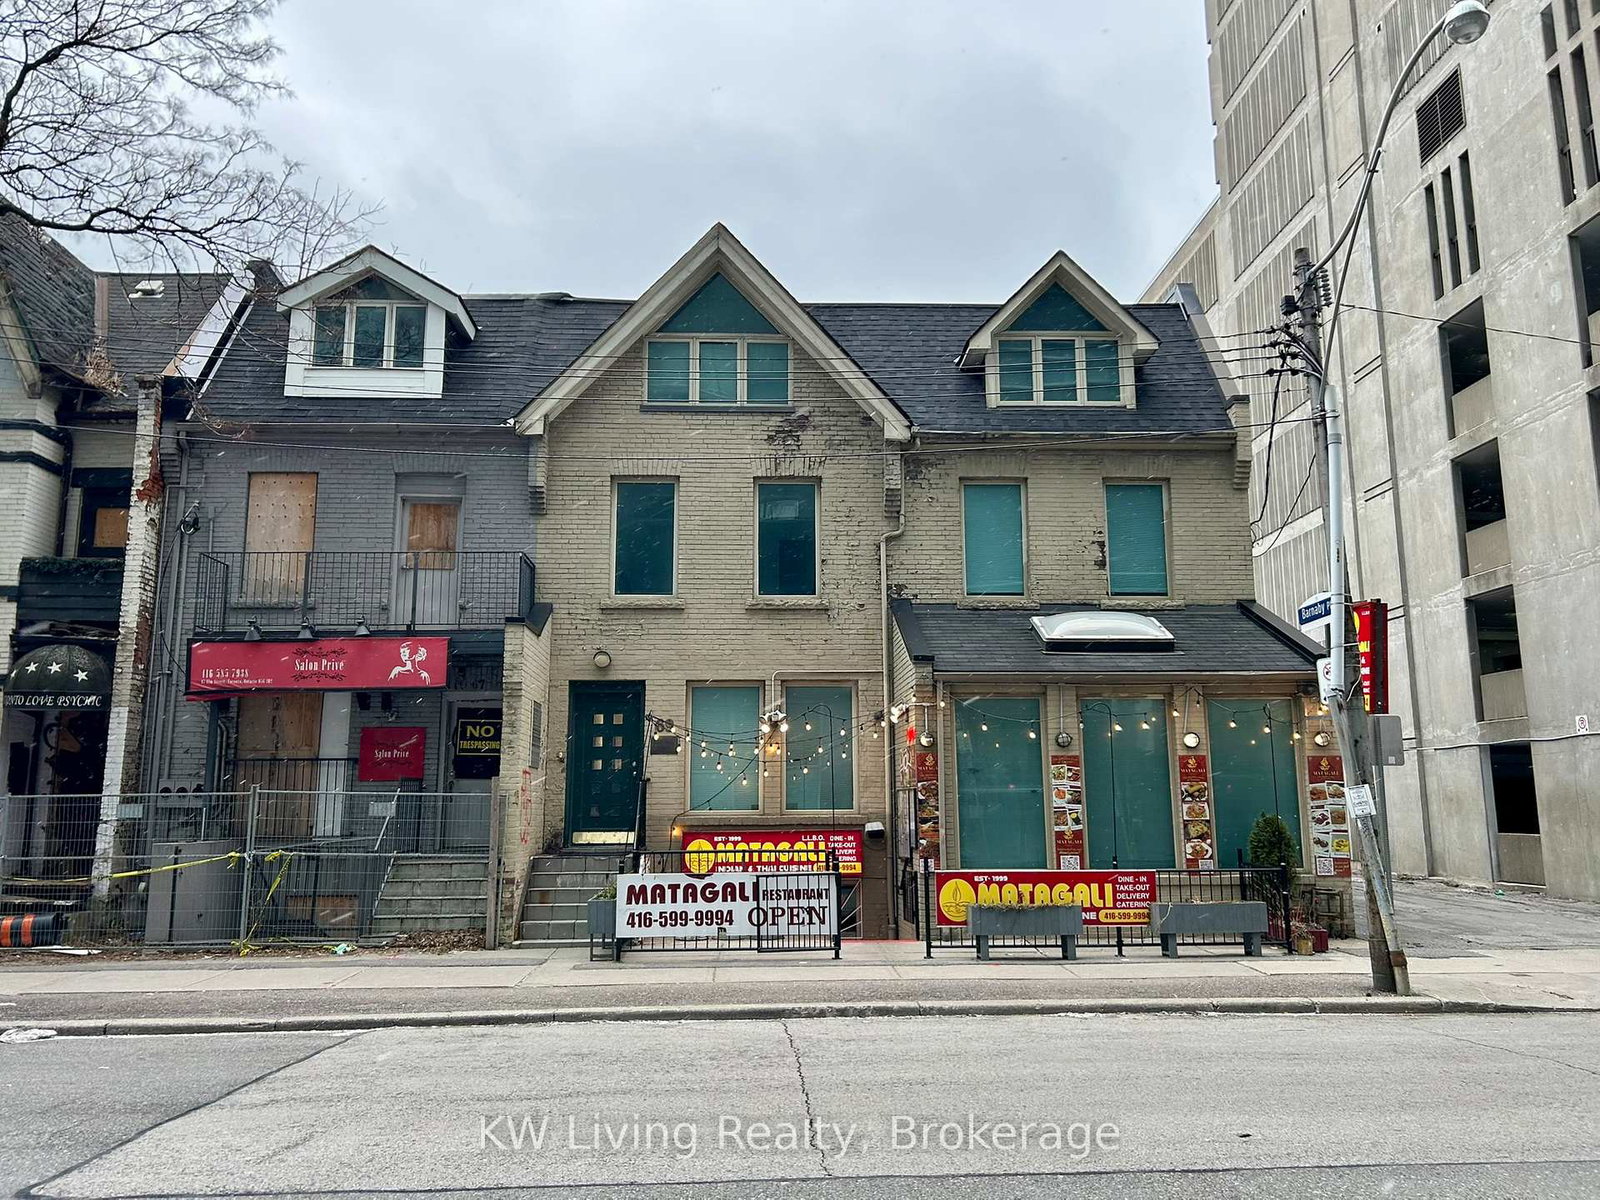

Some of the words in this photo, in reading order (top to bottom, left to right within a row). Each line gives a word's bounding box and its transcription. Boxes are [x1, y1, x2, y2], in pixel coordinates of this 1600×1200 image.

[1301, 602, 1325, 620] Barnaby
[294, 658, 319, 671] Salon
[26, 694, 54, 706] LOVE
[57, 694, 102, 707] PSYCHIC
[466, 725, 495, 738] NO
[460, 741, 500, 749] TRESPASSING
[374, 749, 392, 758] Salon
[717, 842, 826, 863] MATAGALI
[625, 882, 757, 905] MATAGALI
[762, 888, 829, 901] RESTAURANT
[975, 883, 1113, 907] MATAGALI
[626, 910, 734, 928] 416-599-9994
[747, 906, 828, 927] OPEN
